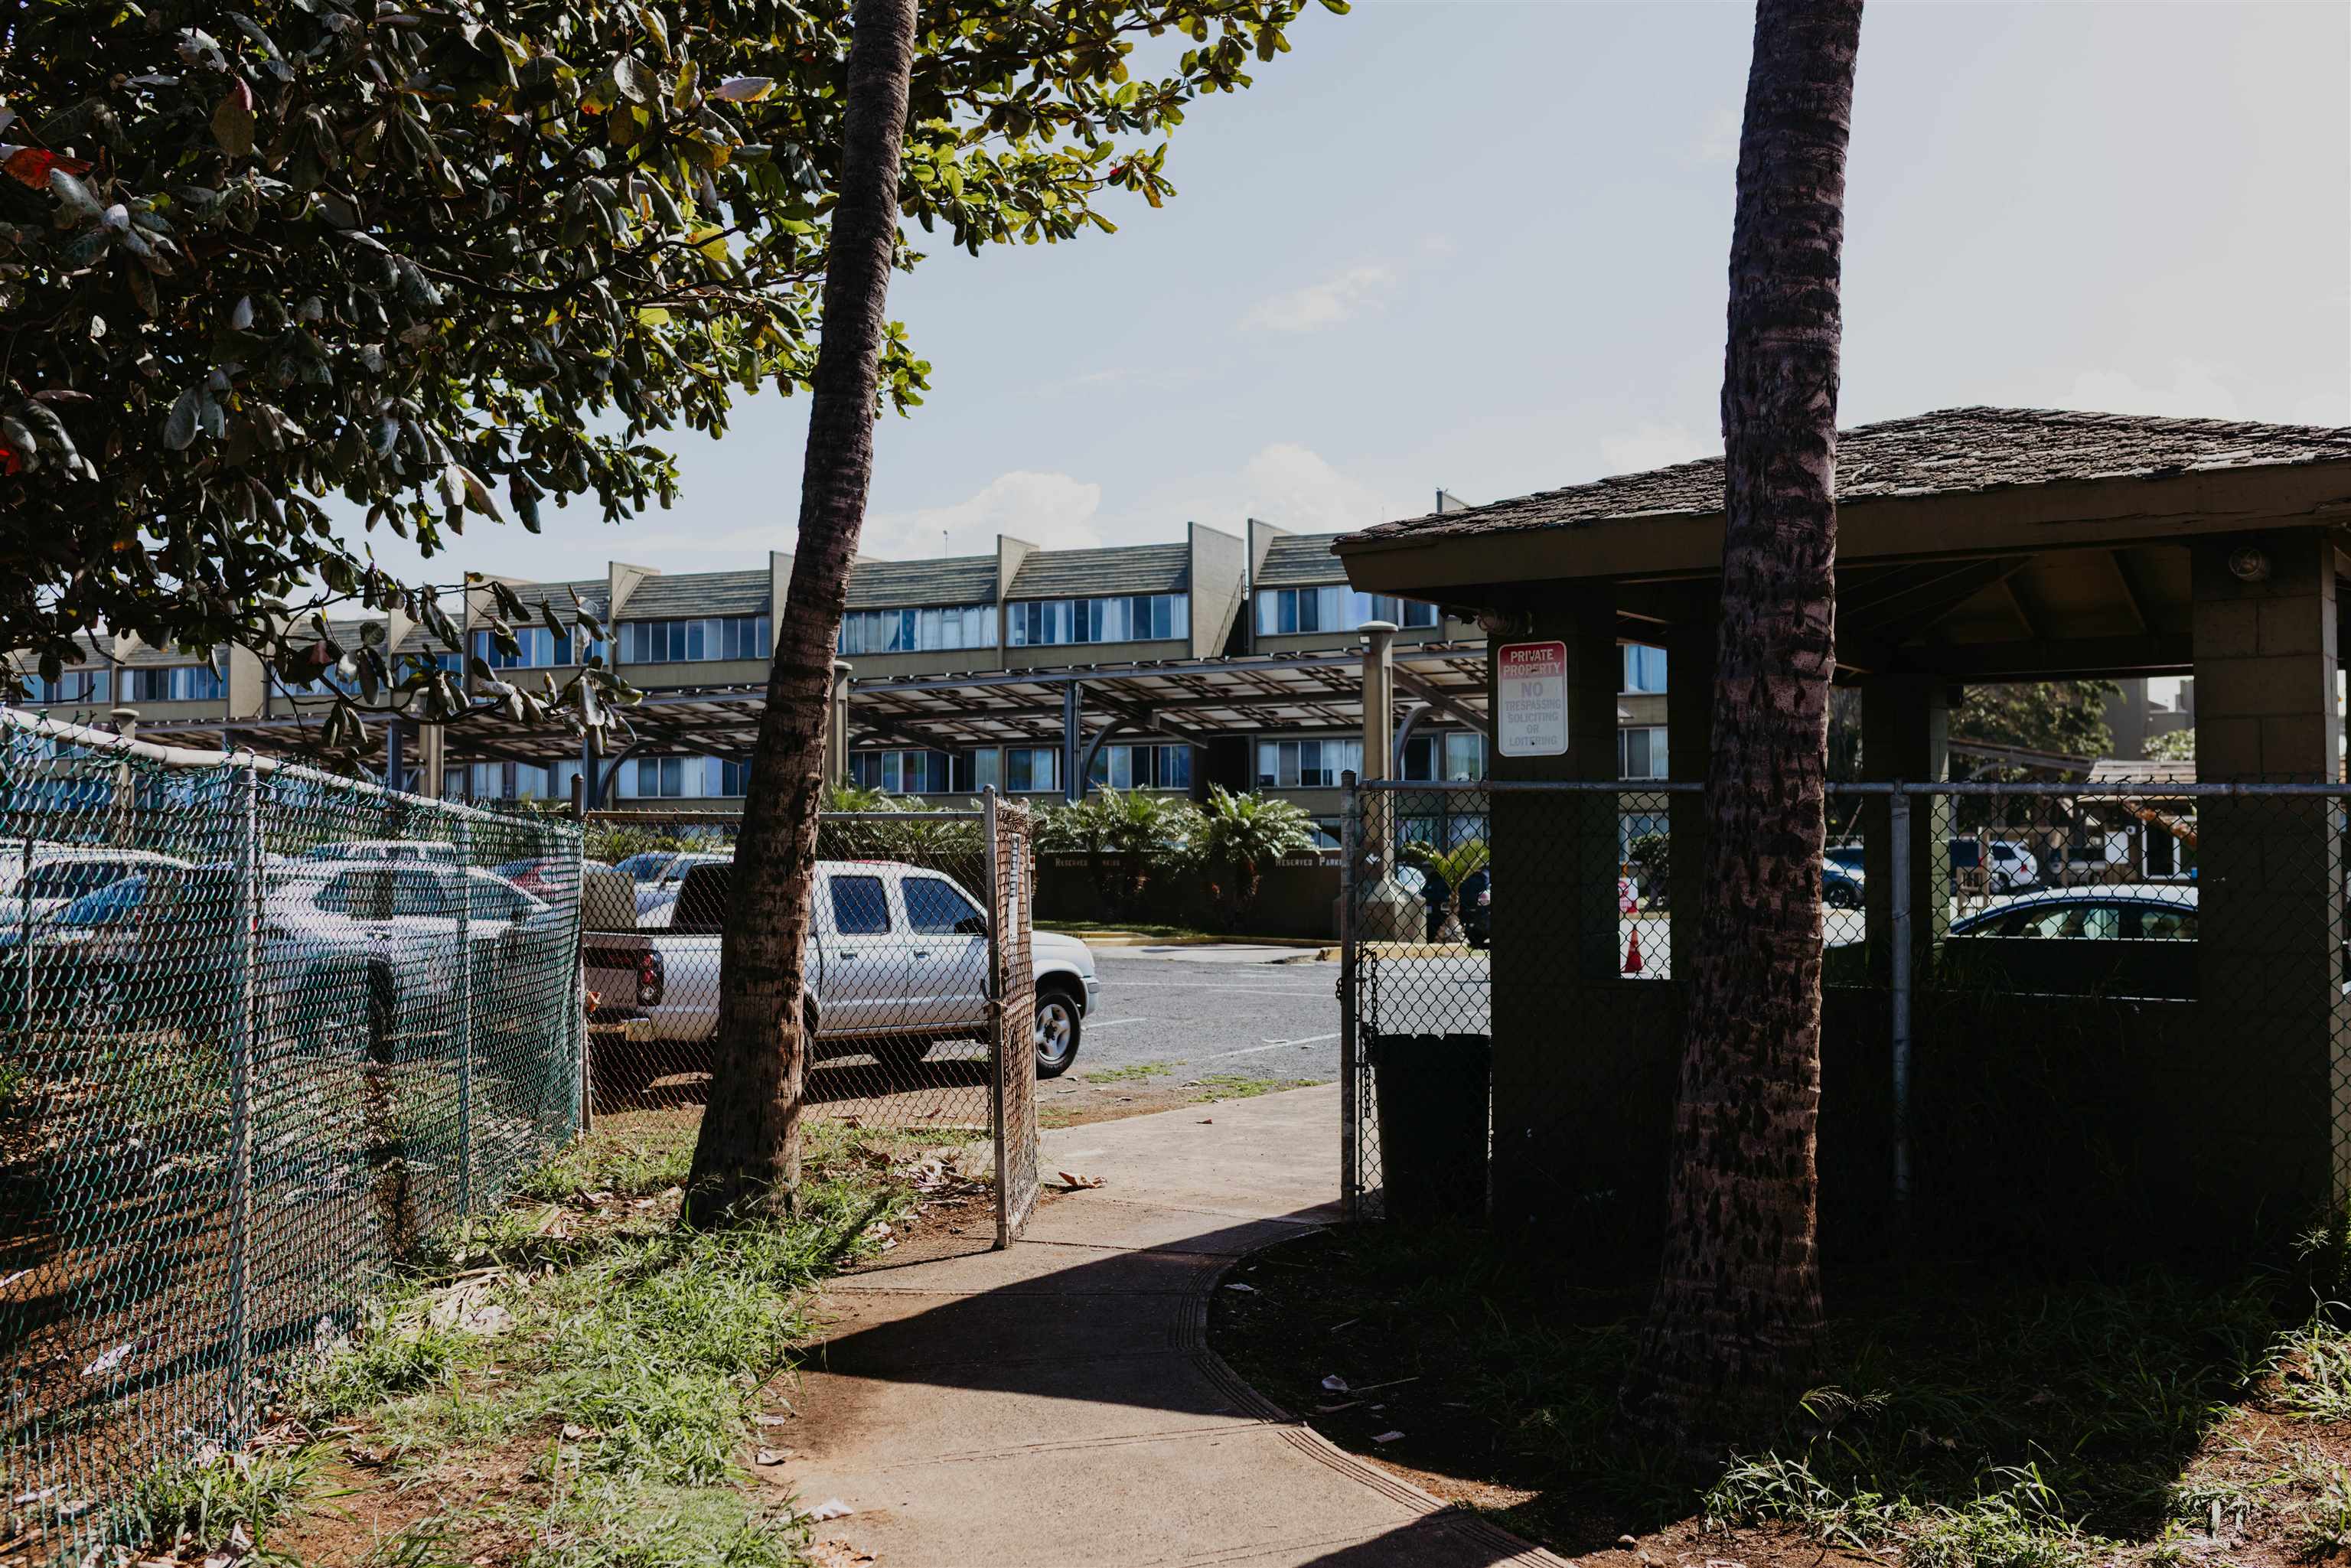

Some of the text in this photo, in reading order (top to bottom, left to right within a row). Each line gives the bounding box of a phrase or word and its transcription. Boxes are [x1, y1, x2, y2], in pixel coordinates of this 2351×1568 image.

[1510, 649, 1554, 662] PRIVATE
[1503, 662, 1561, 676] PROPERTY
[1521, 682, 1544, 697] NO
[1505, 699, 1561, 712] TRESPASSING
[1507, 712, 1558, 723] SOLICITING
[1526, 724, 1539, 734] OR
[1509, 735, 1557, 747] LOITERING
